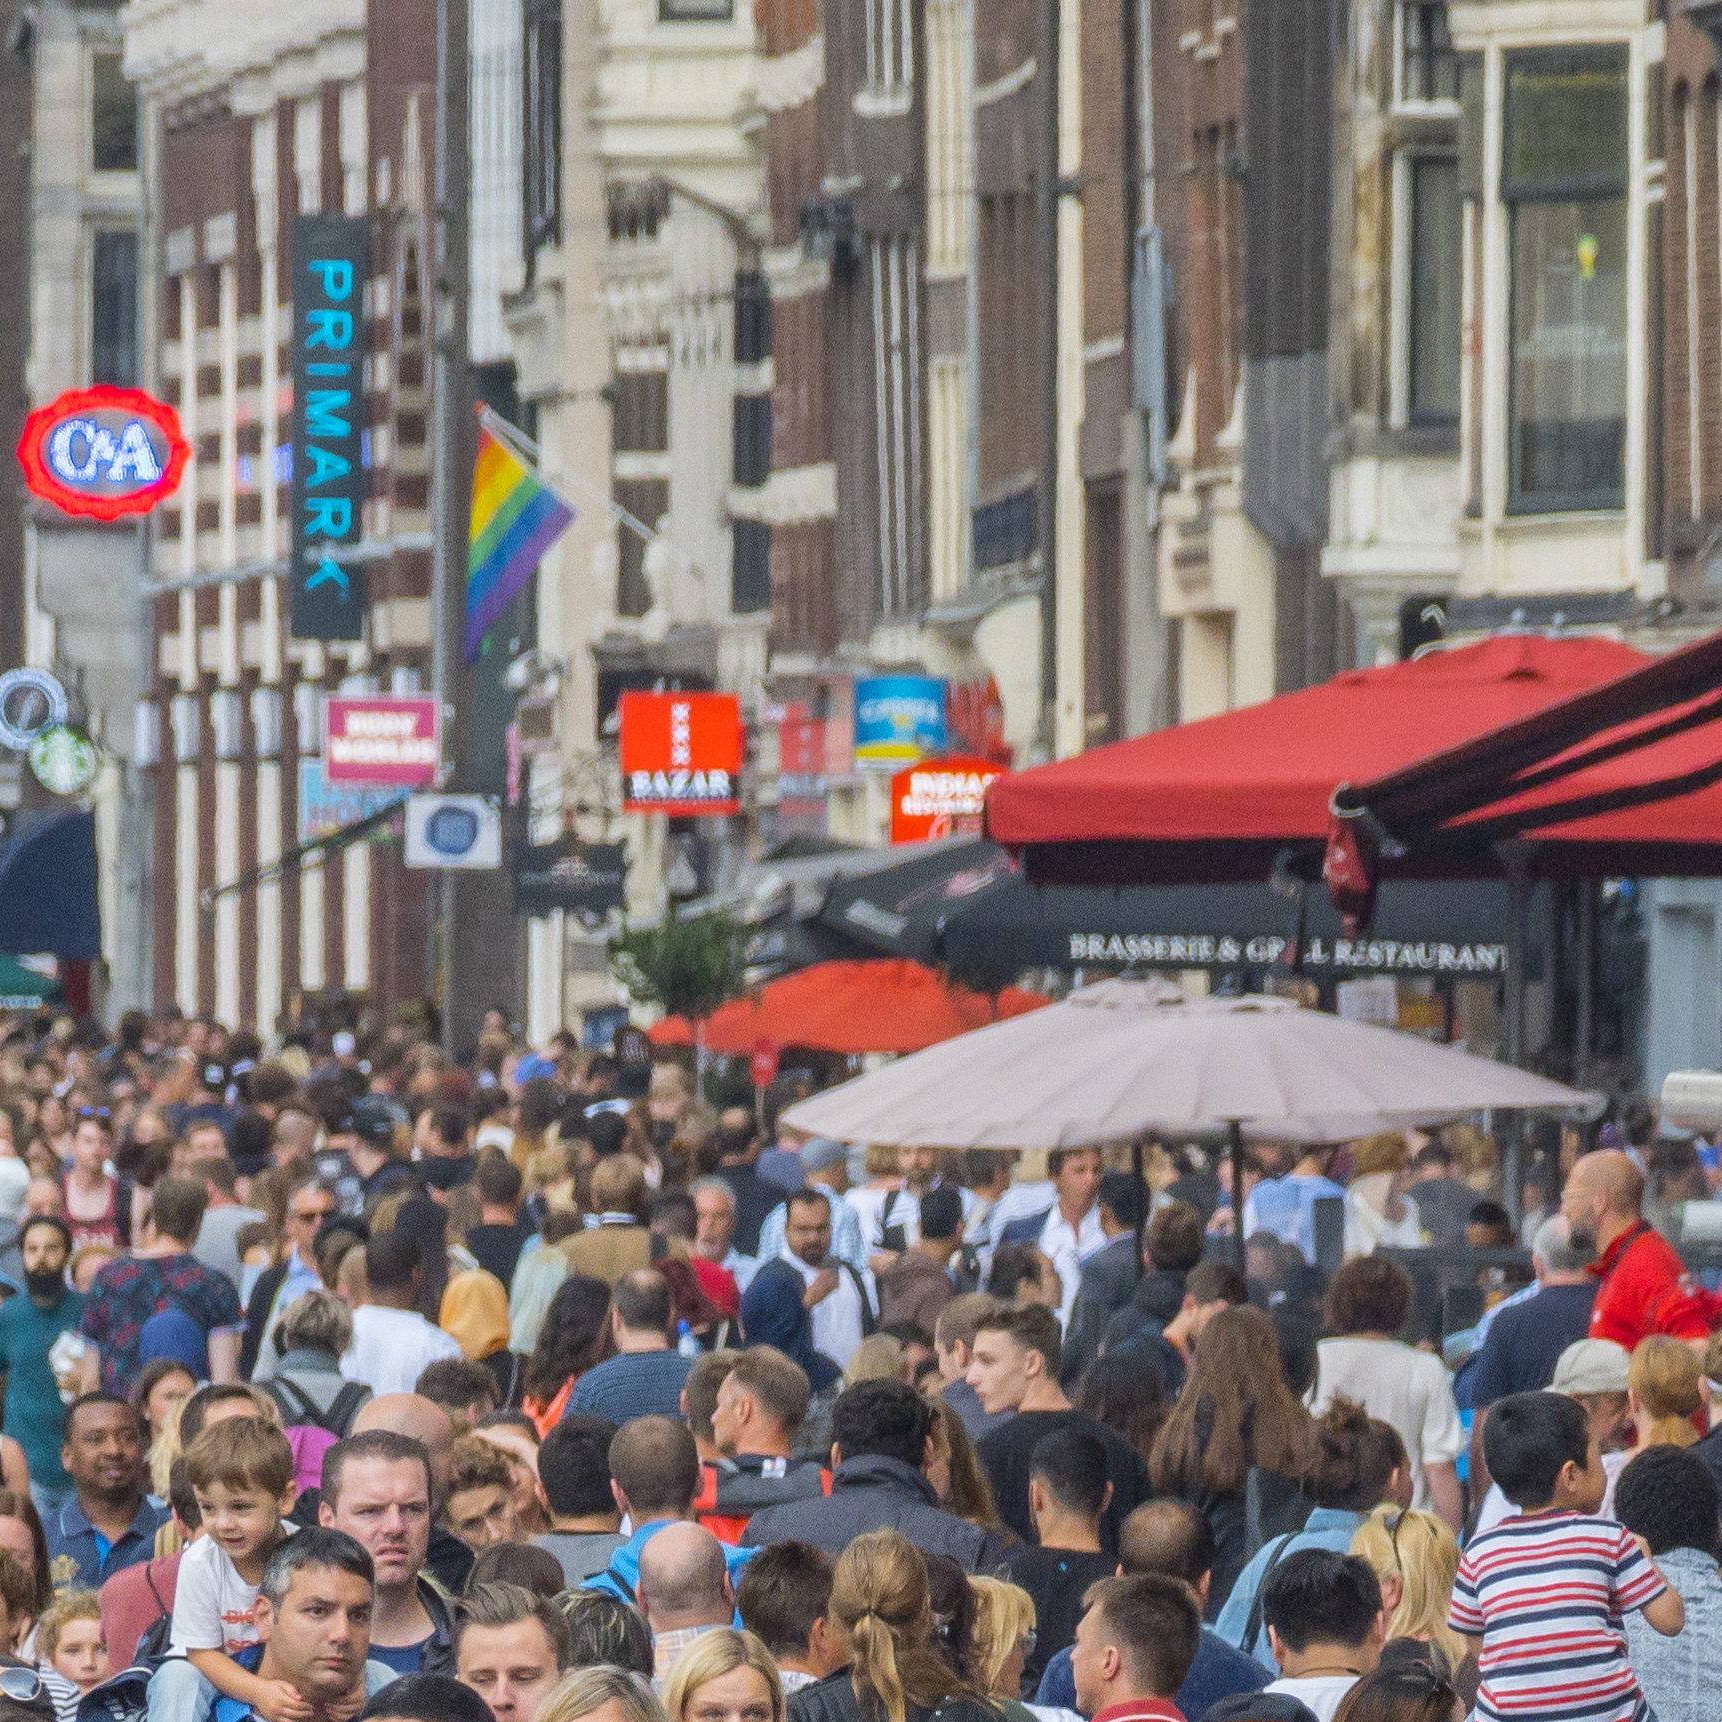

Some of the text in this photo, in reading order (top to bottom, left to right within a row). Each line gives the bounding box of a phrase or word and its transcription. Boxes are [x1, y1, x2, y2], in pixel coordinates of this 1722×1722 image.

[304, 258, 355, 602] PRIMARK
[631, 769, 731, 799] BAZAR
[1069, 933, 1219, 963] BRASSERIE
[1334, 939, 1509, 972] RESTAURANT
